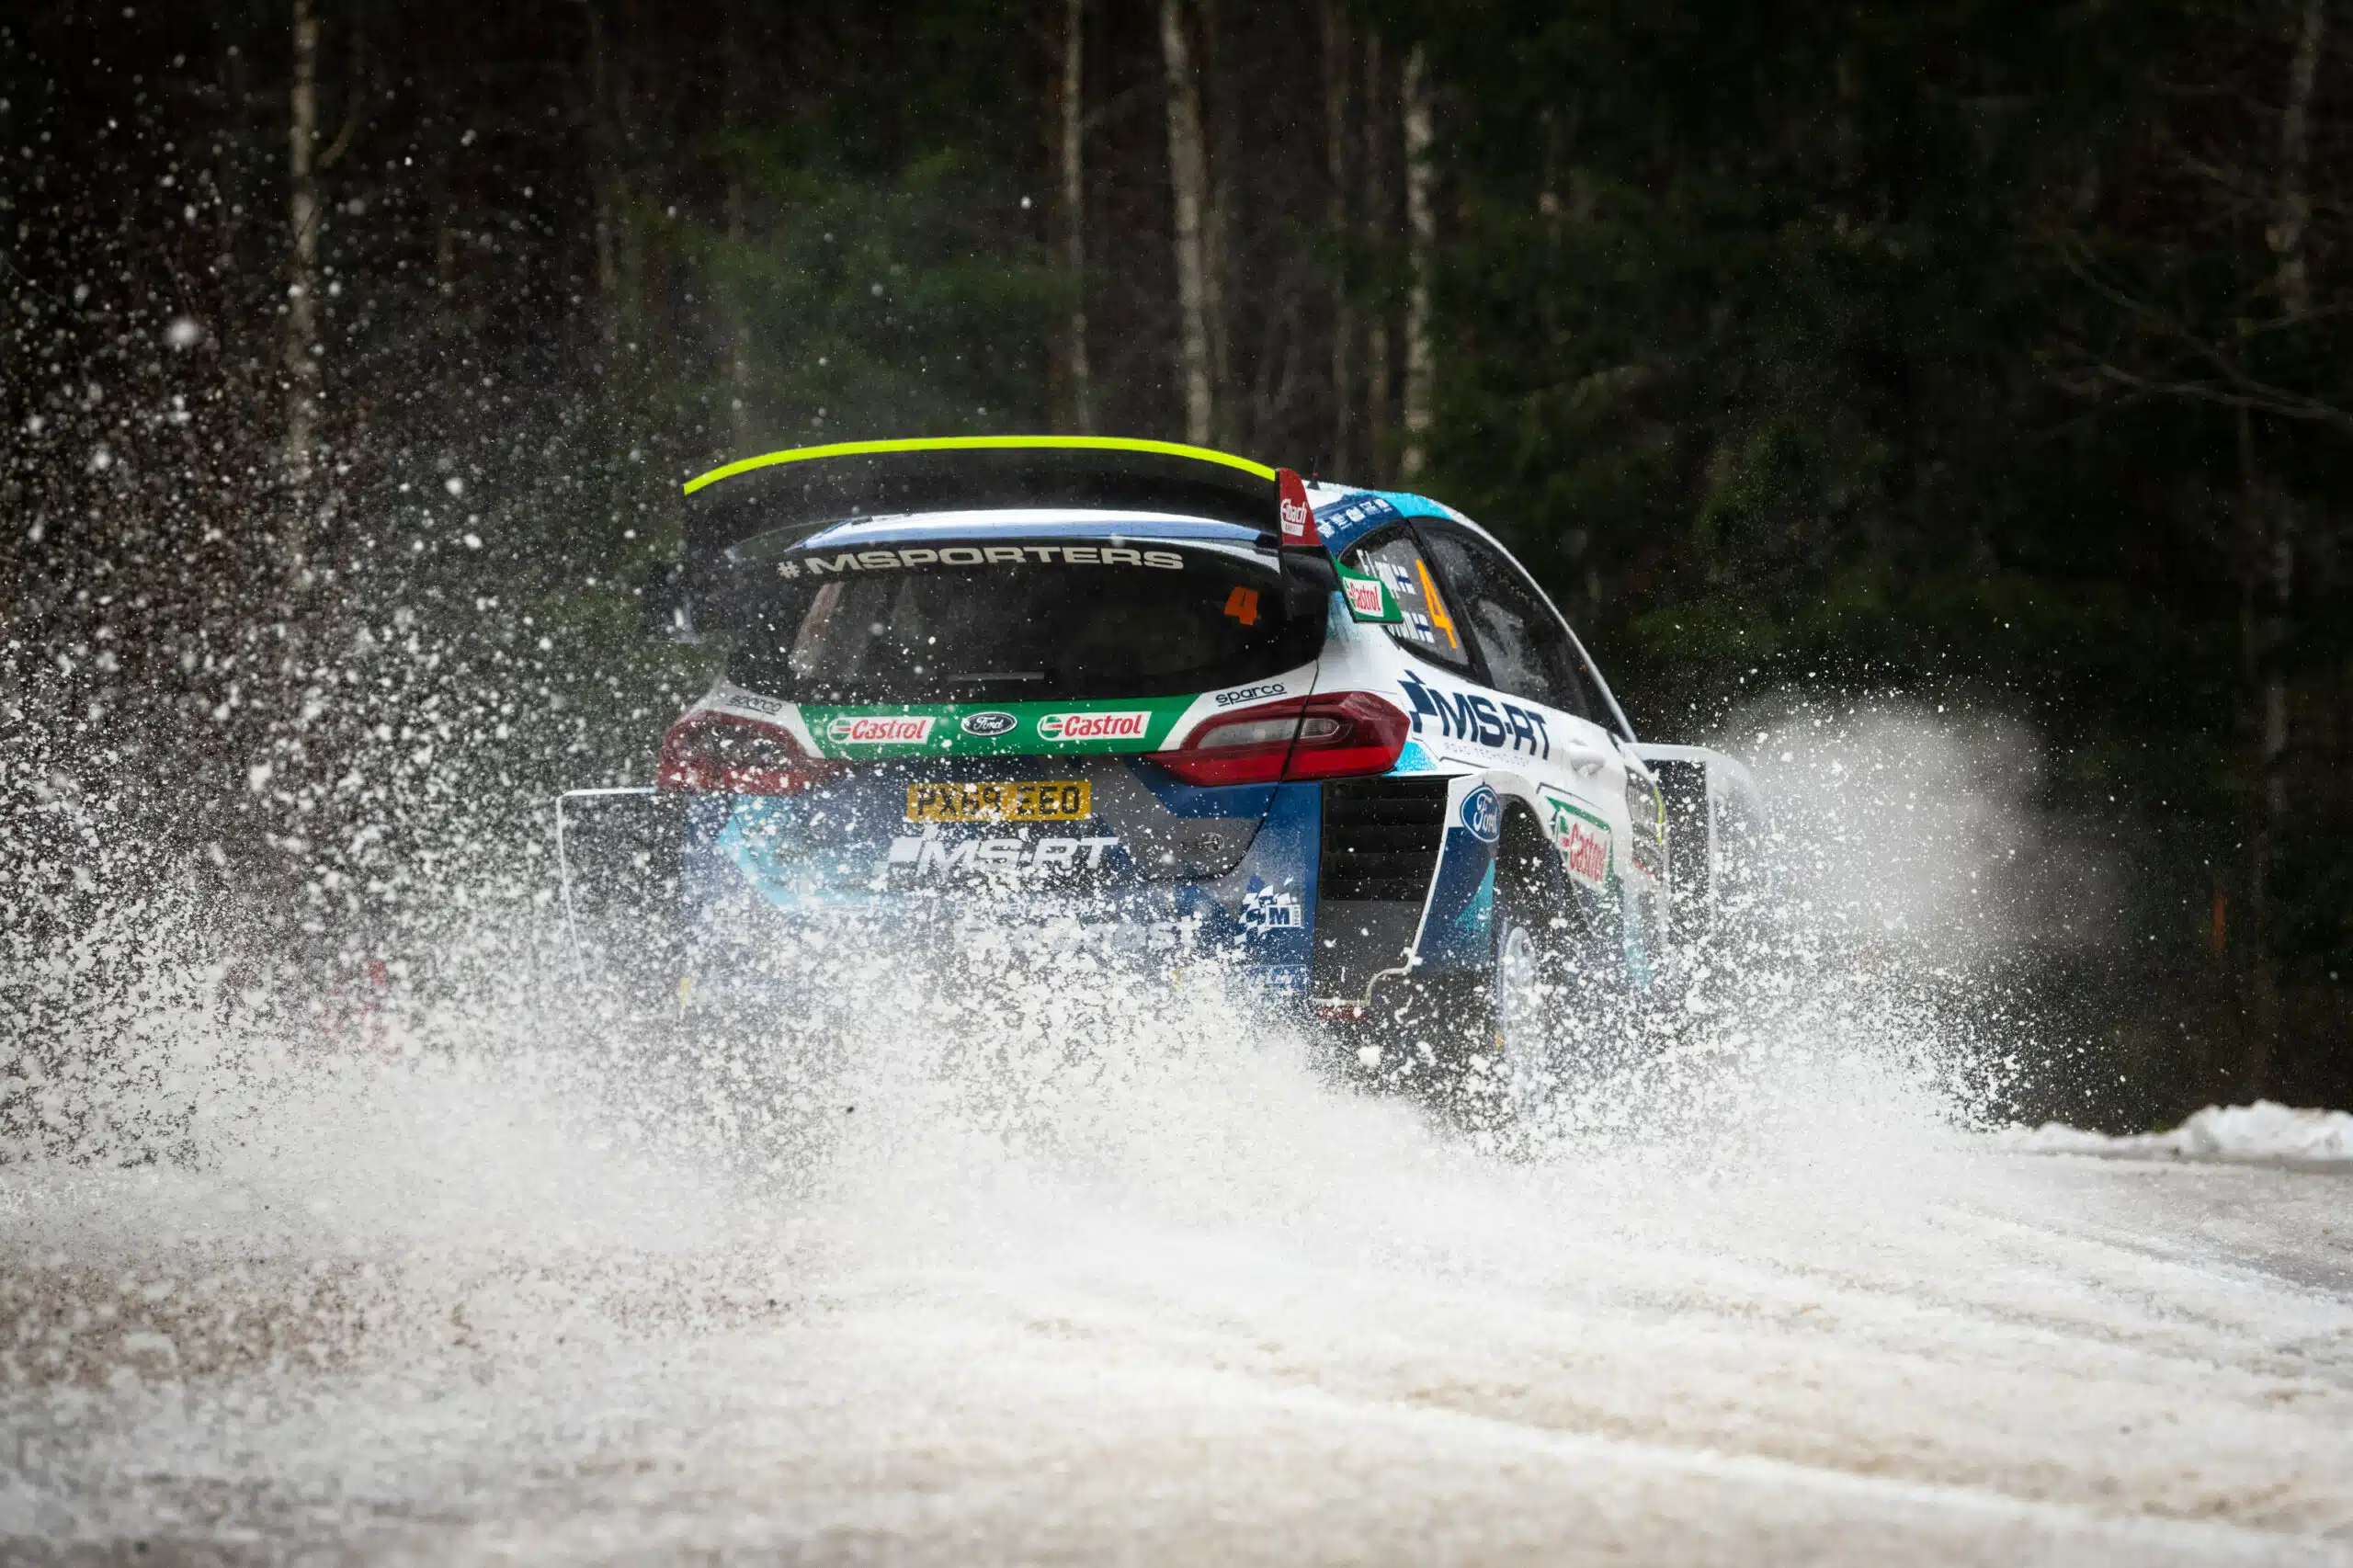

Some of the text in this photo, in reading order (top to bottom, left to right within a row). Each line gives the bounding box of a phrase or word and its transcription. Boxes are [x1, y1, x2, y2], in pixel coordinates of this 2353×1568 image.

[778, 547, 1184, 578] #MSPORTERS
[1224, 586, 1258, 625] 4
[1348, 582, 1381, 611] Castrol
[1415, 559, 1458, 649] 4
[1216, 682, 1286, 707] sparco
[850, 718, 926, 741] Castrol
[973, 715, 1005, 730] Ford
[1064, 714, 1142, 737] Castrol
[1473, 793, 1498, 835] Ford
[1569, 823, 1608, 882] Castrol
